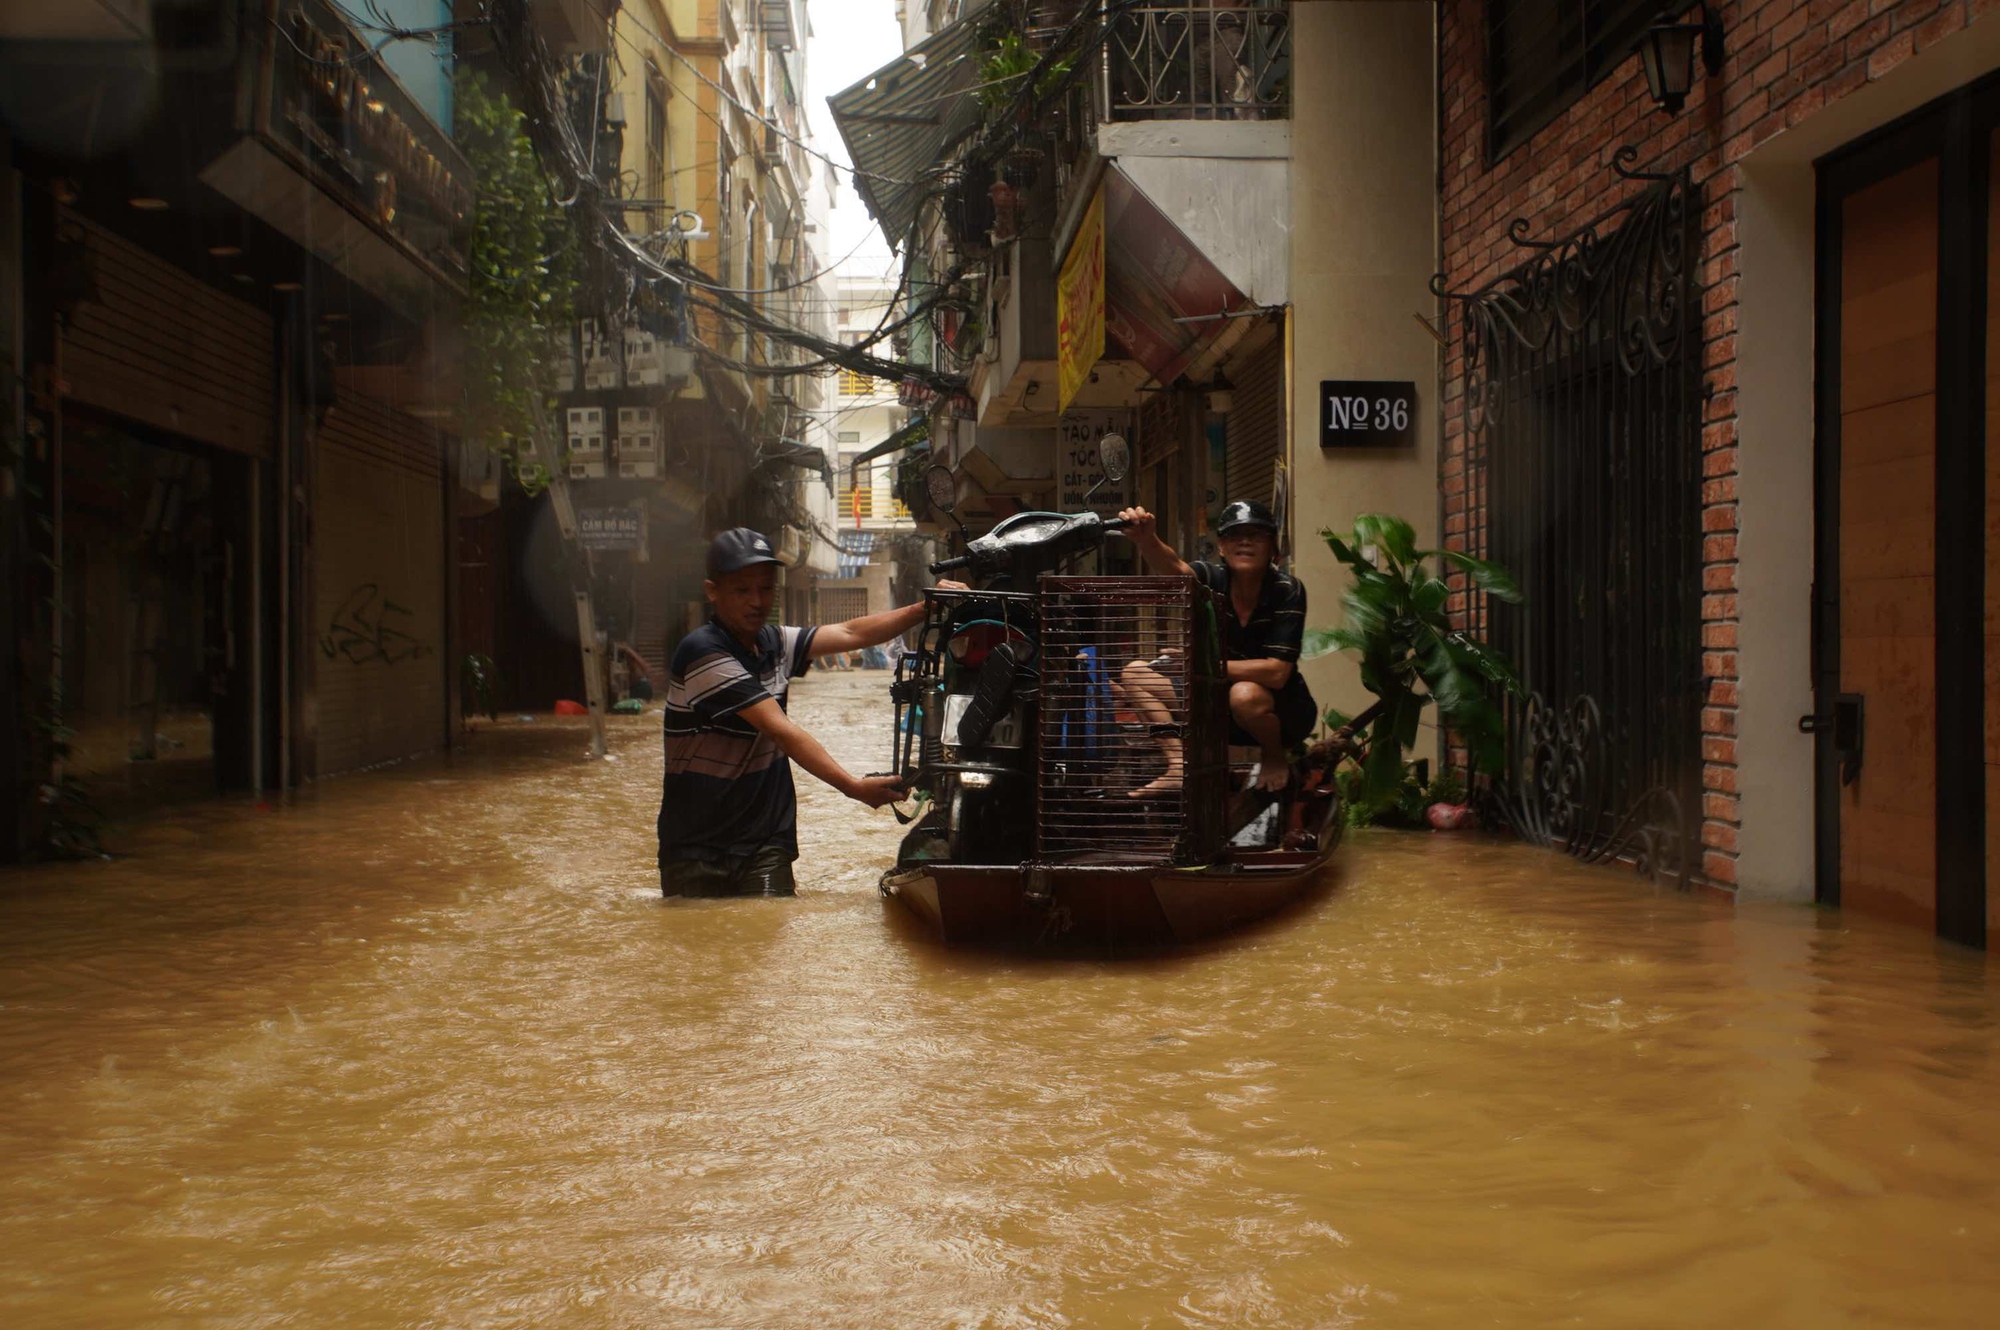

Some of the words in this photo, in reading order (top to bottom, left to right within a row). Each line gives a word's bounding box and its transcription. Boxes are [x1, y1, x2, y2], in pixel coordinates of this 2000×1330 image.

[1374, 397, 1408, 431] 36
[1062, 425, 1090, 445] TẠO
[1069, 445, 1096, 467] TÓC
